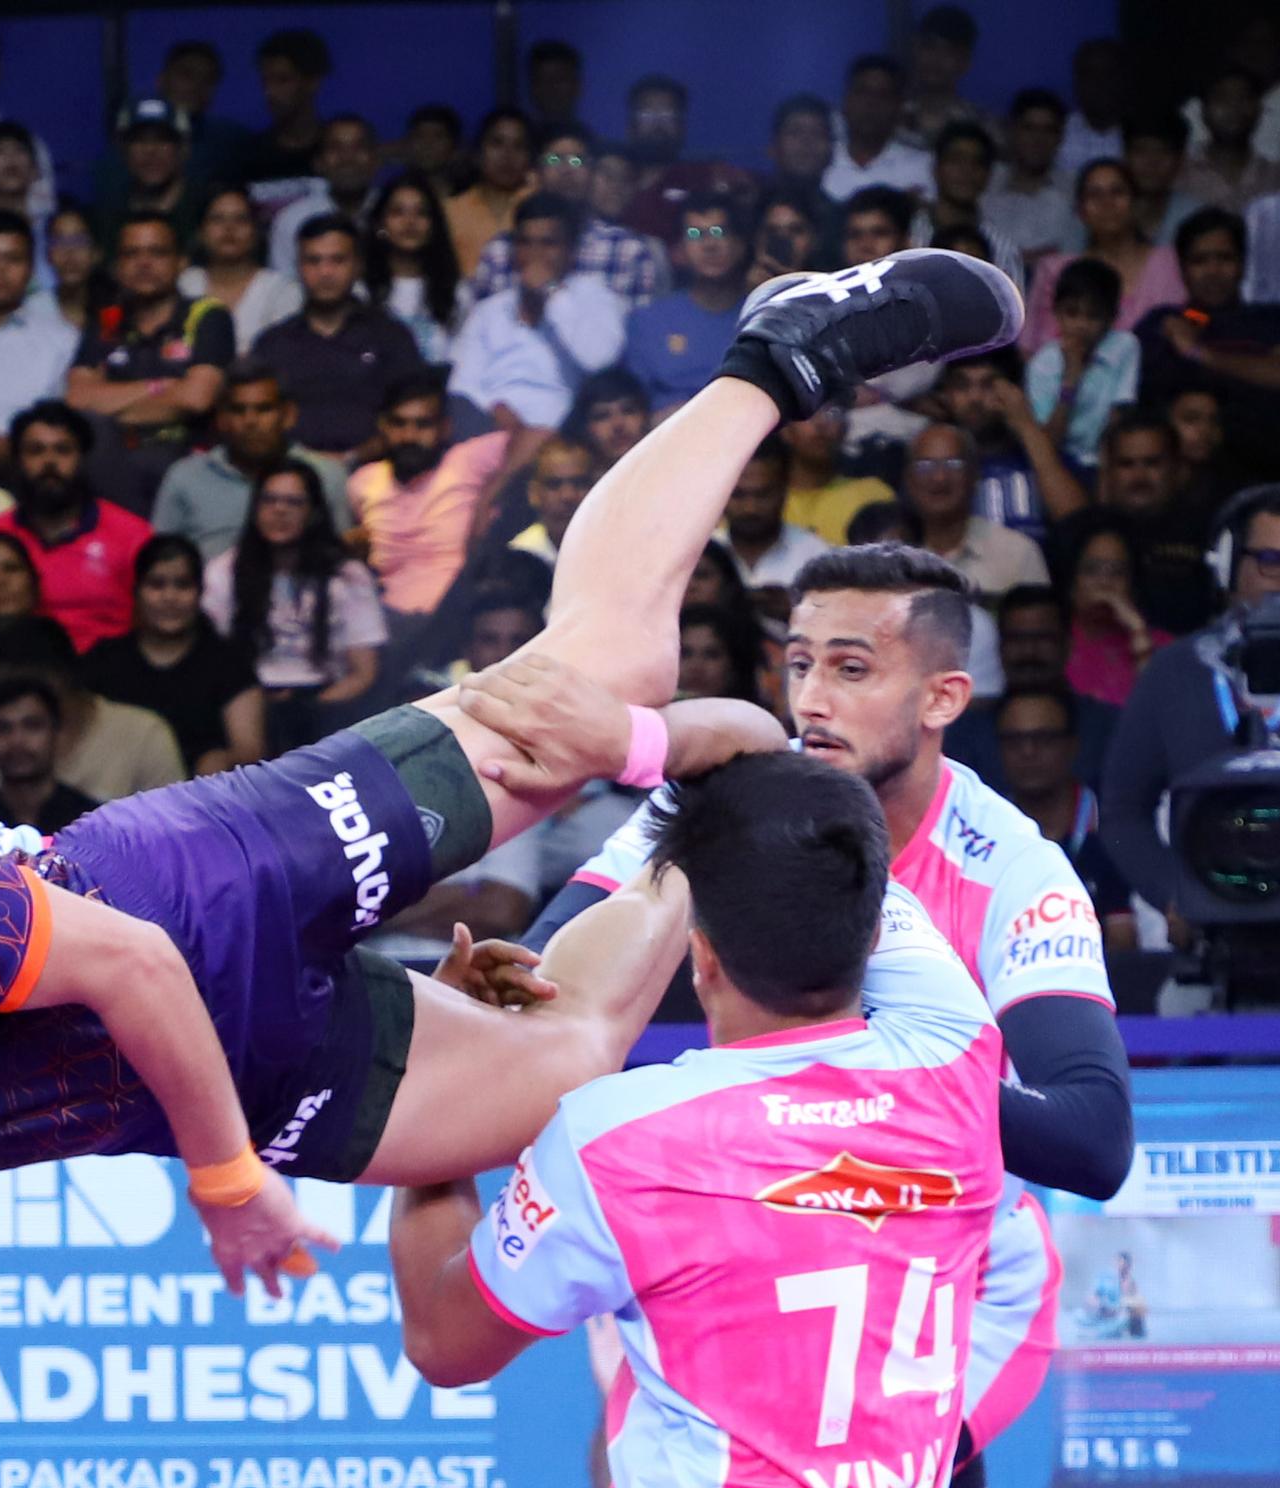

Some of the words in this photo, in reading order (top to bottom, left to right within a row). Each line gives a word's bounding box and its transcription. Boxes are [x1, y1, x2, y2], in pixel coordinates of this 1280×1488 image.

[1006, 934, 1104, 976] finan
[244, 1272, 403, 1326] BAS
[775, 1256, 957, 1447] 74
